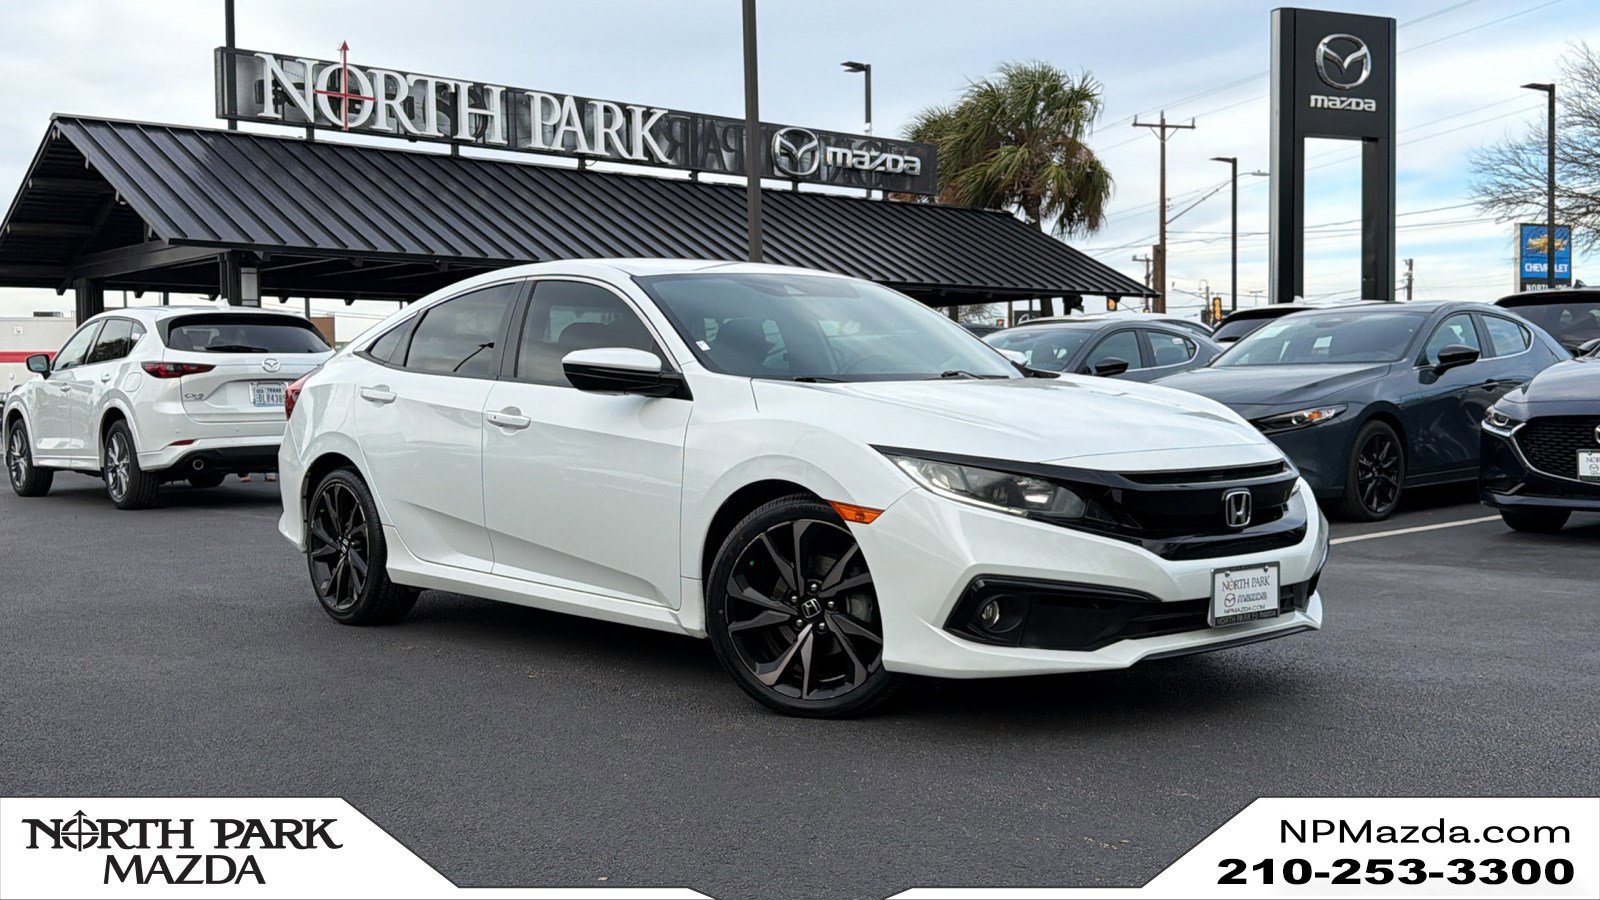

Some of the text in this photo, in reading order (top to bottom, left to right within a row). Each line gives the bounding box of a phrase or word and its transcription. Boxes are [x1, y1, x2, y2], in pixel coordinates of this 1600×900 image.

[254, 52, 507, 146] NORTH
[523, 90, 672, 165] PARK
[1525, 263, 1568, 273] CHEVRLET
[1222, 576, 1270, 592] NORTH PARK
